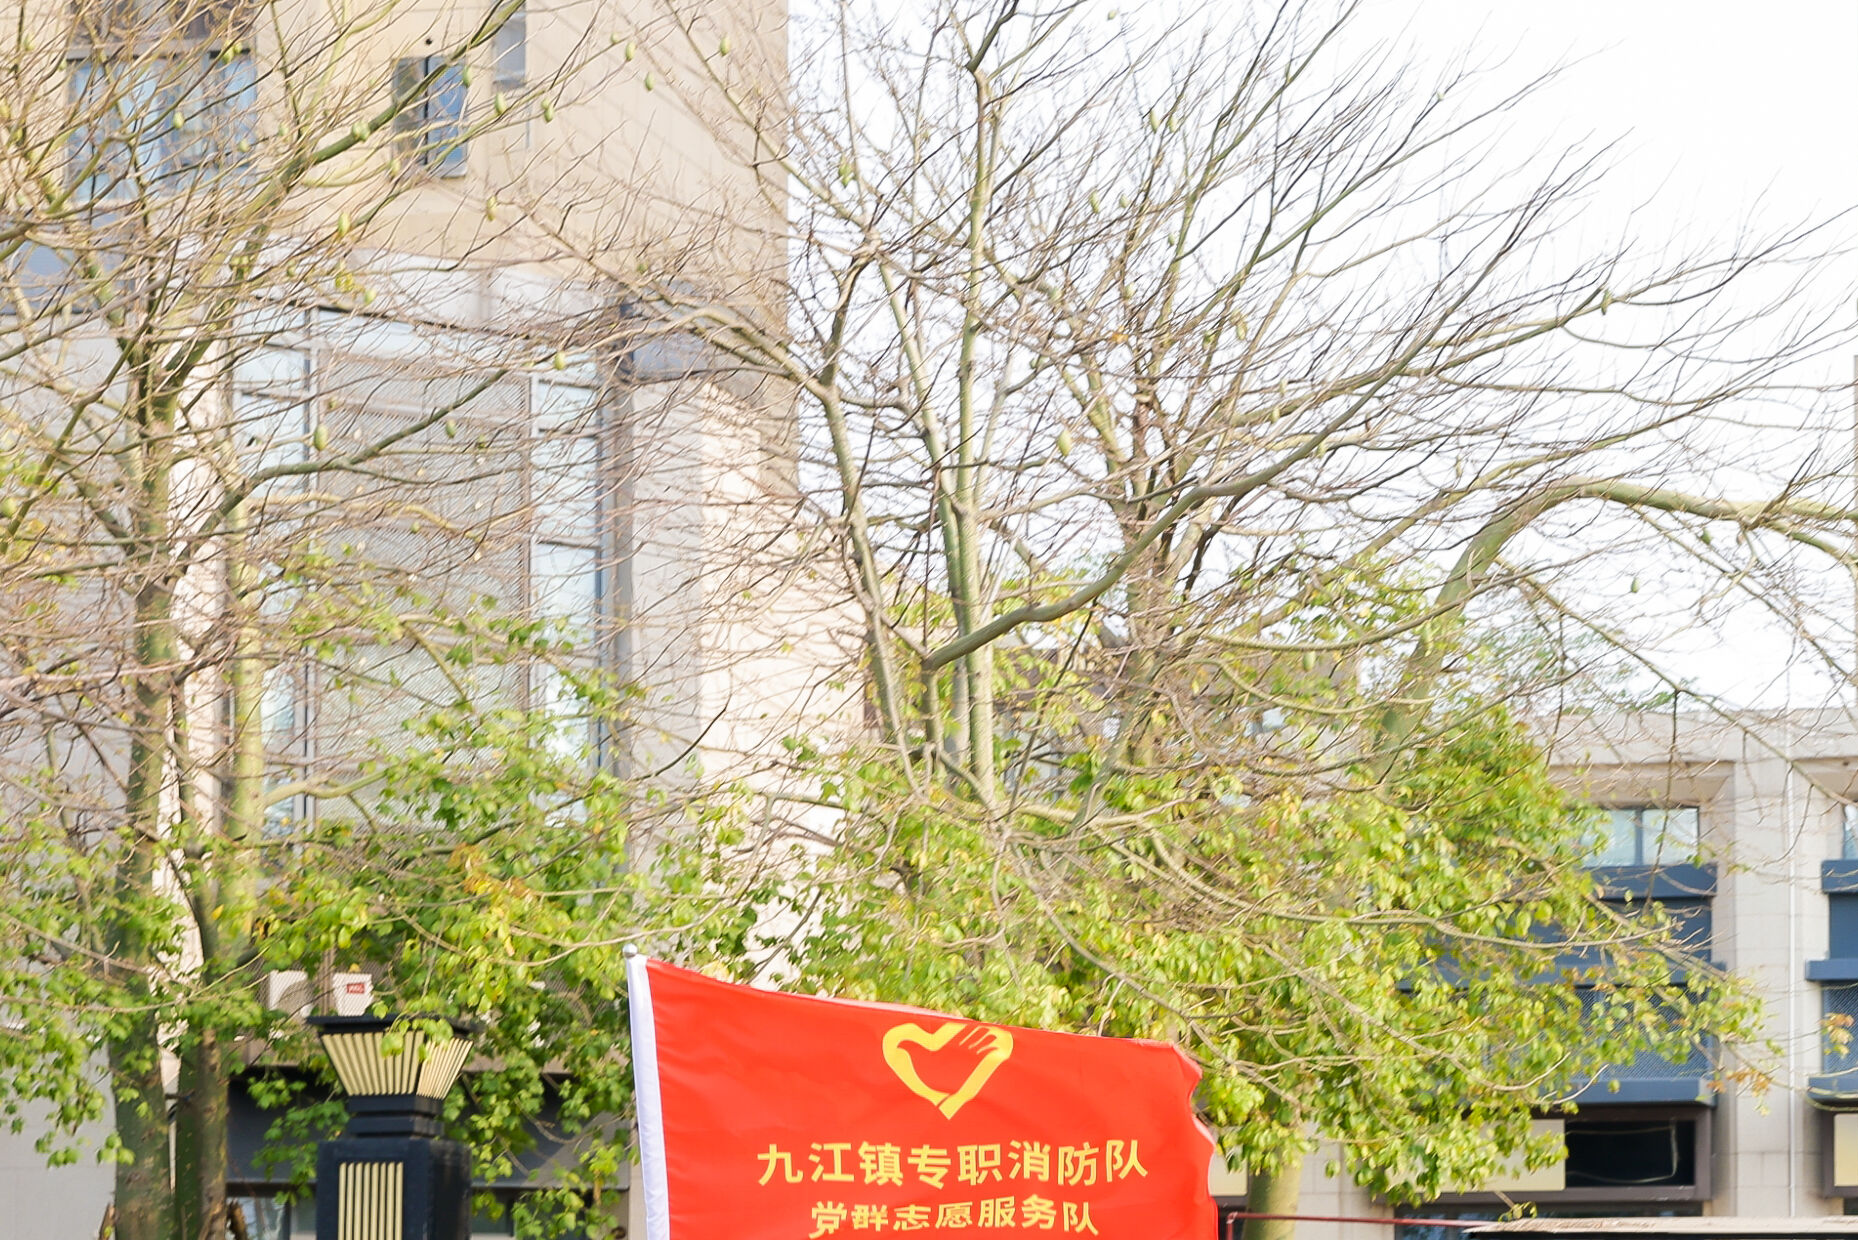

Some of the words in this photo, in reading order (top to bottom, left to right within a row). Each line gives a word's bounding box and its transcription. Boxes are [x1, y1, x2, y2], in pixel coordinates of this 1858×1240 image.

[756, 1138, 1148, 1190] 九江镇专职消防队
[808, 1193, 1100, 1240] 党群志愿服务队
